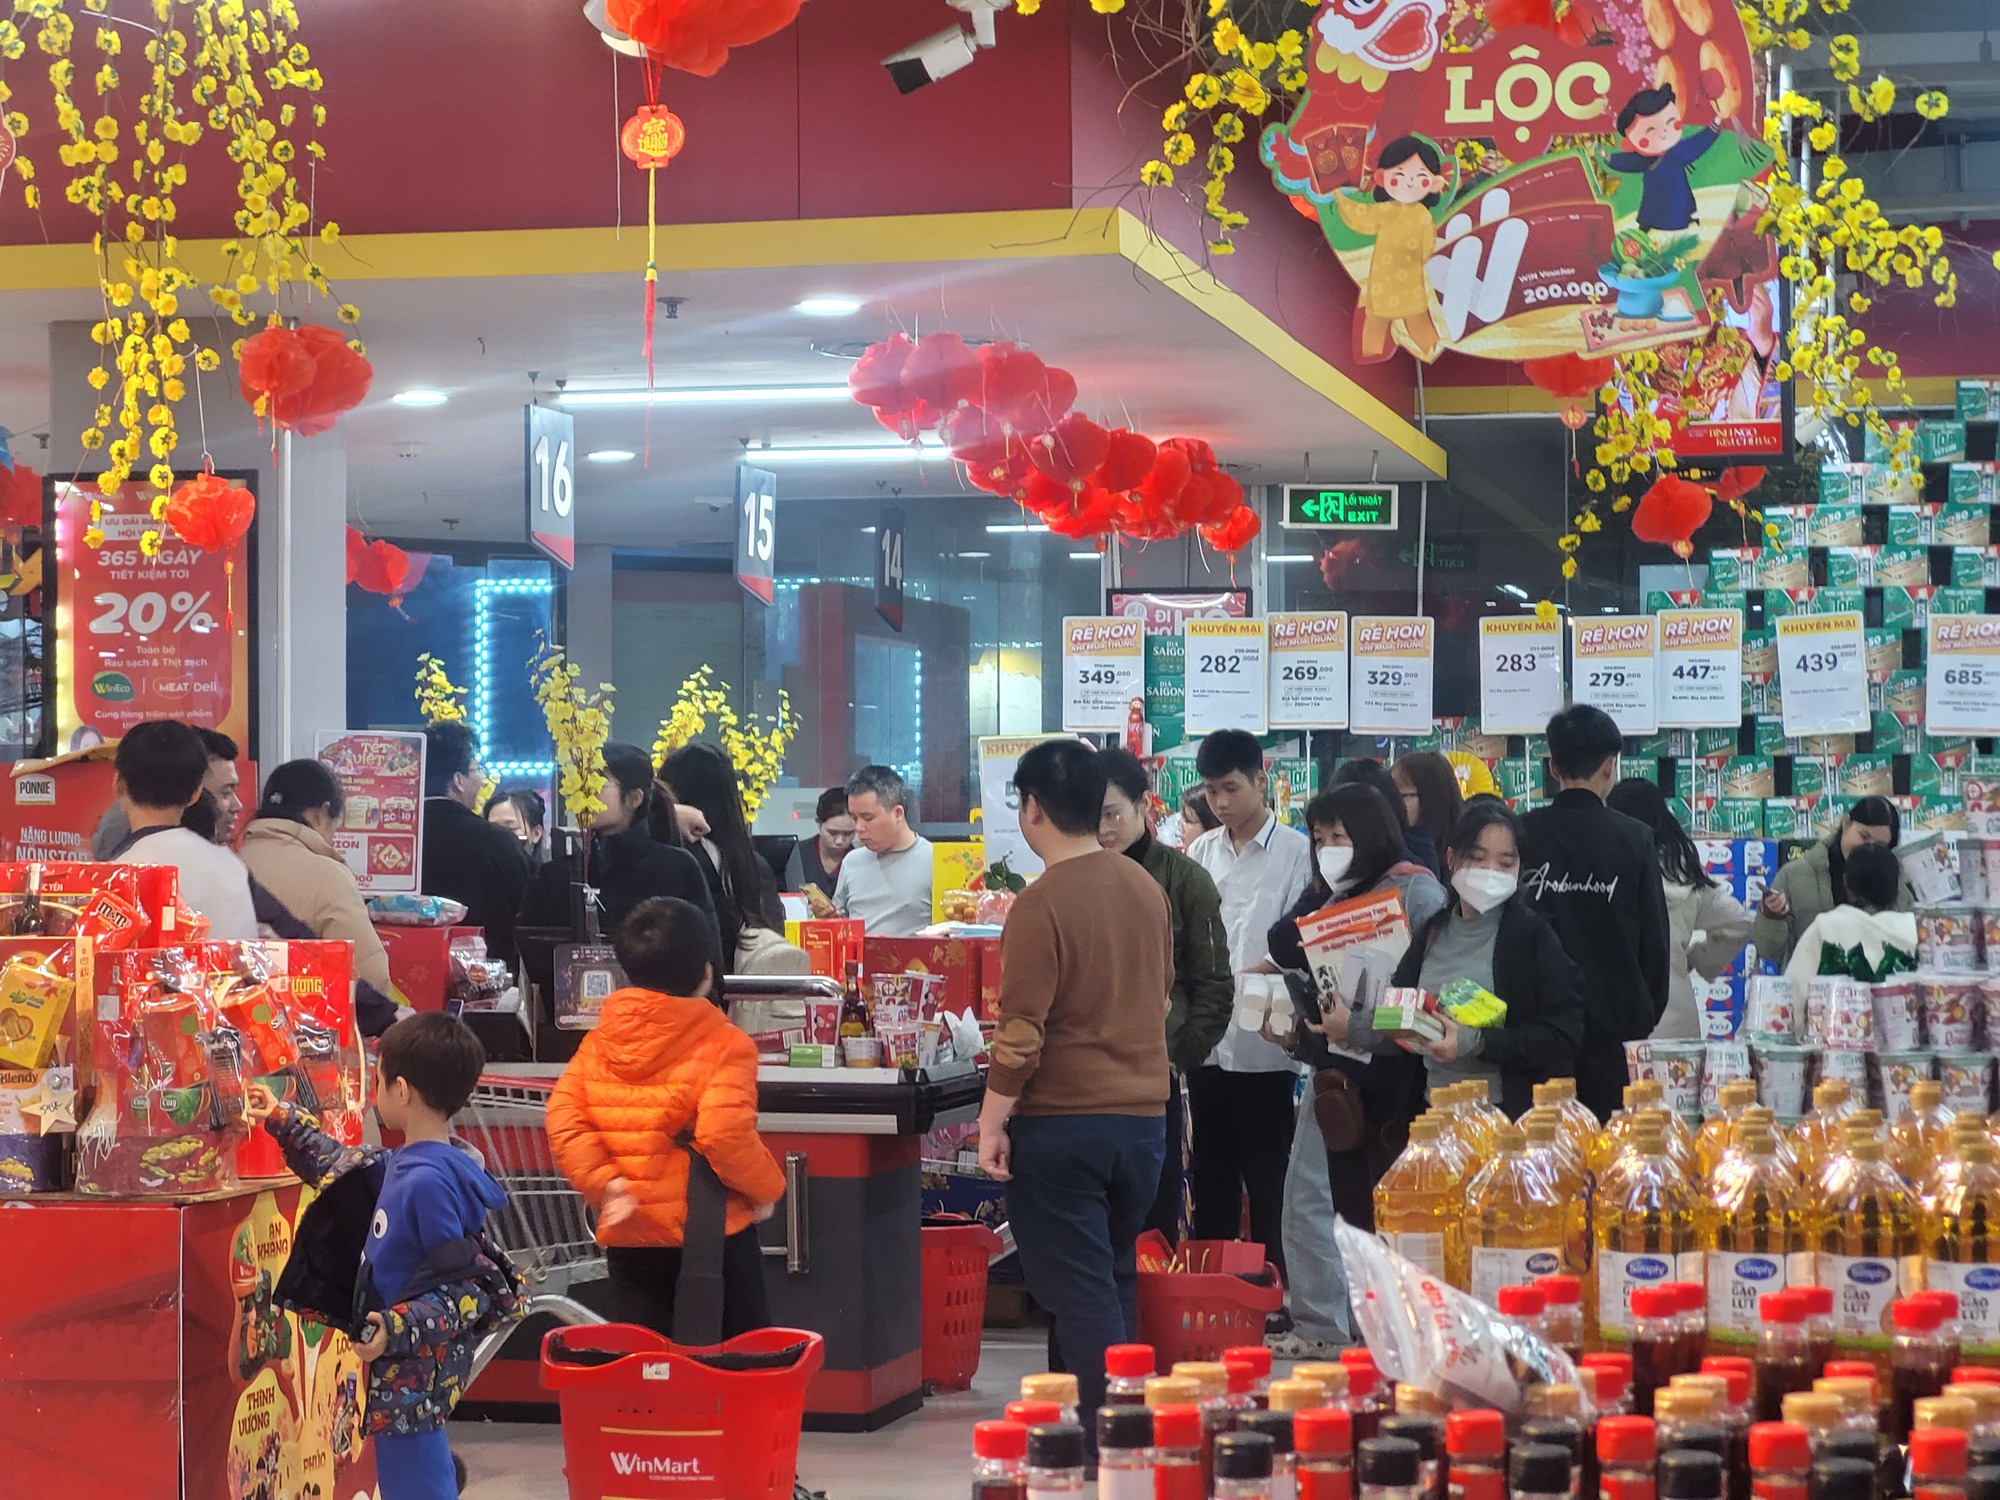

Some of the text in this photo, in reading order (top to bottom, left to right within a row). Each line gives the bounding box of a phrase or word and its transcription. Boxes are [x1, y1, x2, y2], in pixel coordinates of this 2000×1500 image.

[1444, 44, 1611, 143] LỘC
[1523, 281, 1609, 304] 200.000
[534, 435, 573, 518] 16
[1347, 511, 1379, 522] EXIT
[744, 491, 775, 561] 15
[97, 551, 138, 566] 365
[881, 527, 903, 592] 14
[89, 591, 213, 635] 20%
[104, 659, 124, 667] Rau
[152, 659, 159, 667] &
[1200, 655, 1241, 673] 282
[1496, 653, 1536, 672] 283
[1796, 652, 1838, 673] 439
[1078, 670, 1115, 684] 349
[1282, 666, 1318, 680] 269
[1367, 670, 1403, 685] 329
[1589, 672, 1625, 687] 279
[1672, 665, 1710, 679] 447
[1944, 670, 1983, 685] 685
[94, 683, 131, 694] WinEco
[159, 681, 217, 692] MEAT Deli
[19, 781, 52, 794] PONNIE
[269, 1222, 282, 1239] AN
[257, 1238, 288, 1260] KHANG
[610, 1451, 701, 1475] WinMart
